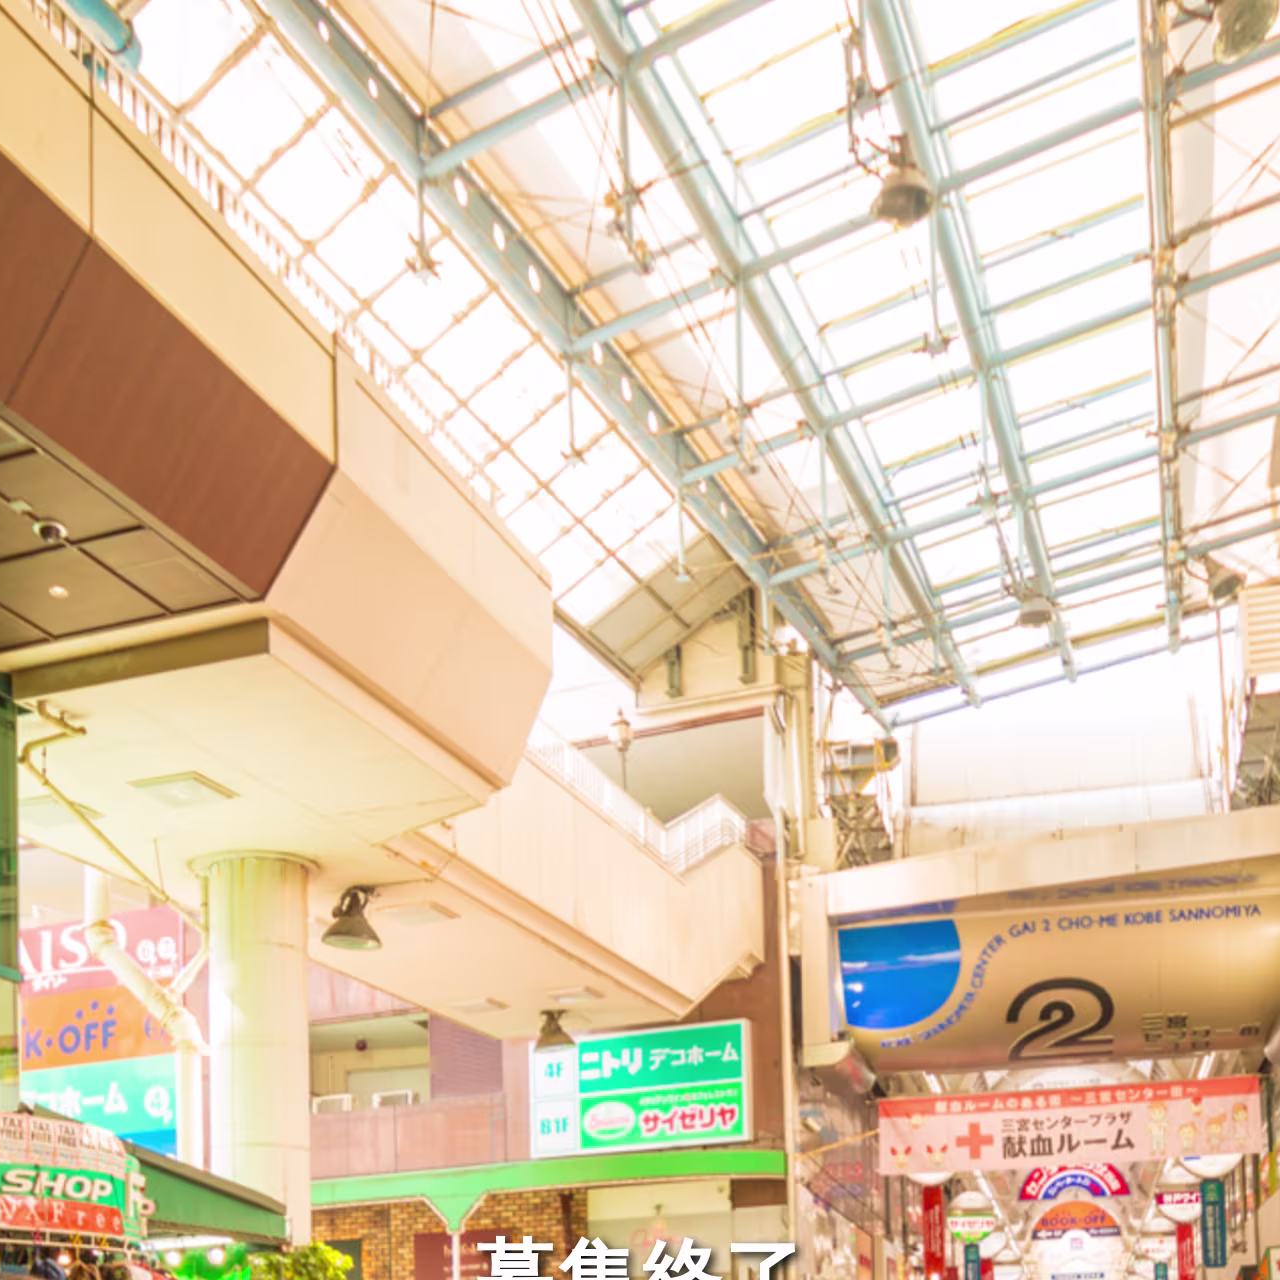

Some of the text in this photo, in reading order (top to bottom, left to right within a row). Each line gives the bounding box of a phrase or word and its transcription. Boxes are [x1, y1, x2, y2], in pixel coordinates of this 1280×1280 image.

[970, 933, 1007, 989] CENTER
[1008, 920, 1037, 939] GAI
[1042, 918, 1051, 933] 2
[1057, 914, 1119, 930] CHO-ME
[1124, 909, 1164, 925] KOBE
[1168, 903, 1262, 923] SANNOMIYA
[544, 1062, 564, 1078] 4F
[581, 1042, 740, 1080] ニトリ デコホーム
[1, 1116, 24, 1129] TAX
[640, 1104, 738, 1136] サイゼリヤ
[1001, 1111, 1134, 1133] 三宮センタープラザ
[1001, 1128, 1136, 1160] 献血ルーム
[0, 1168, 115, 1201] SHOP
[53, 1201, 122, 1232] Free
